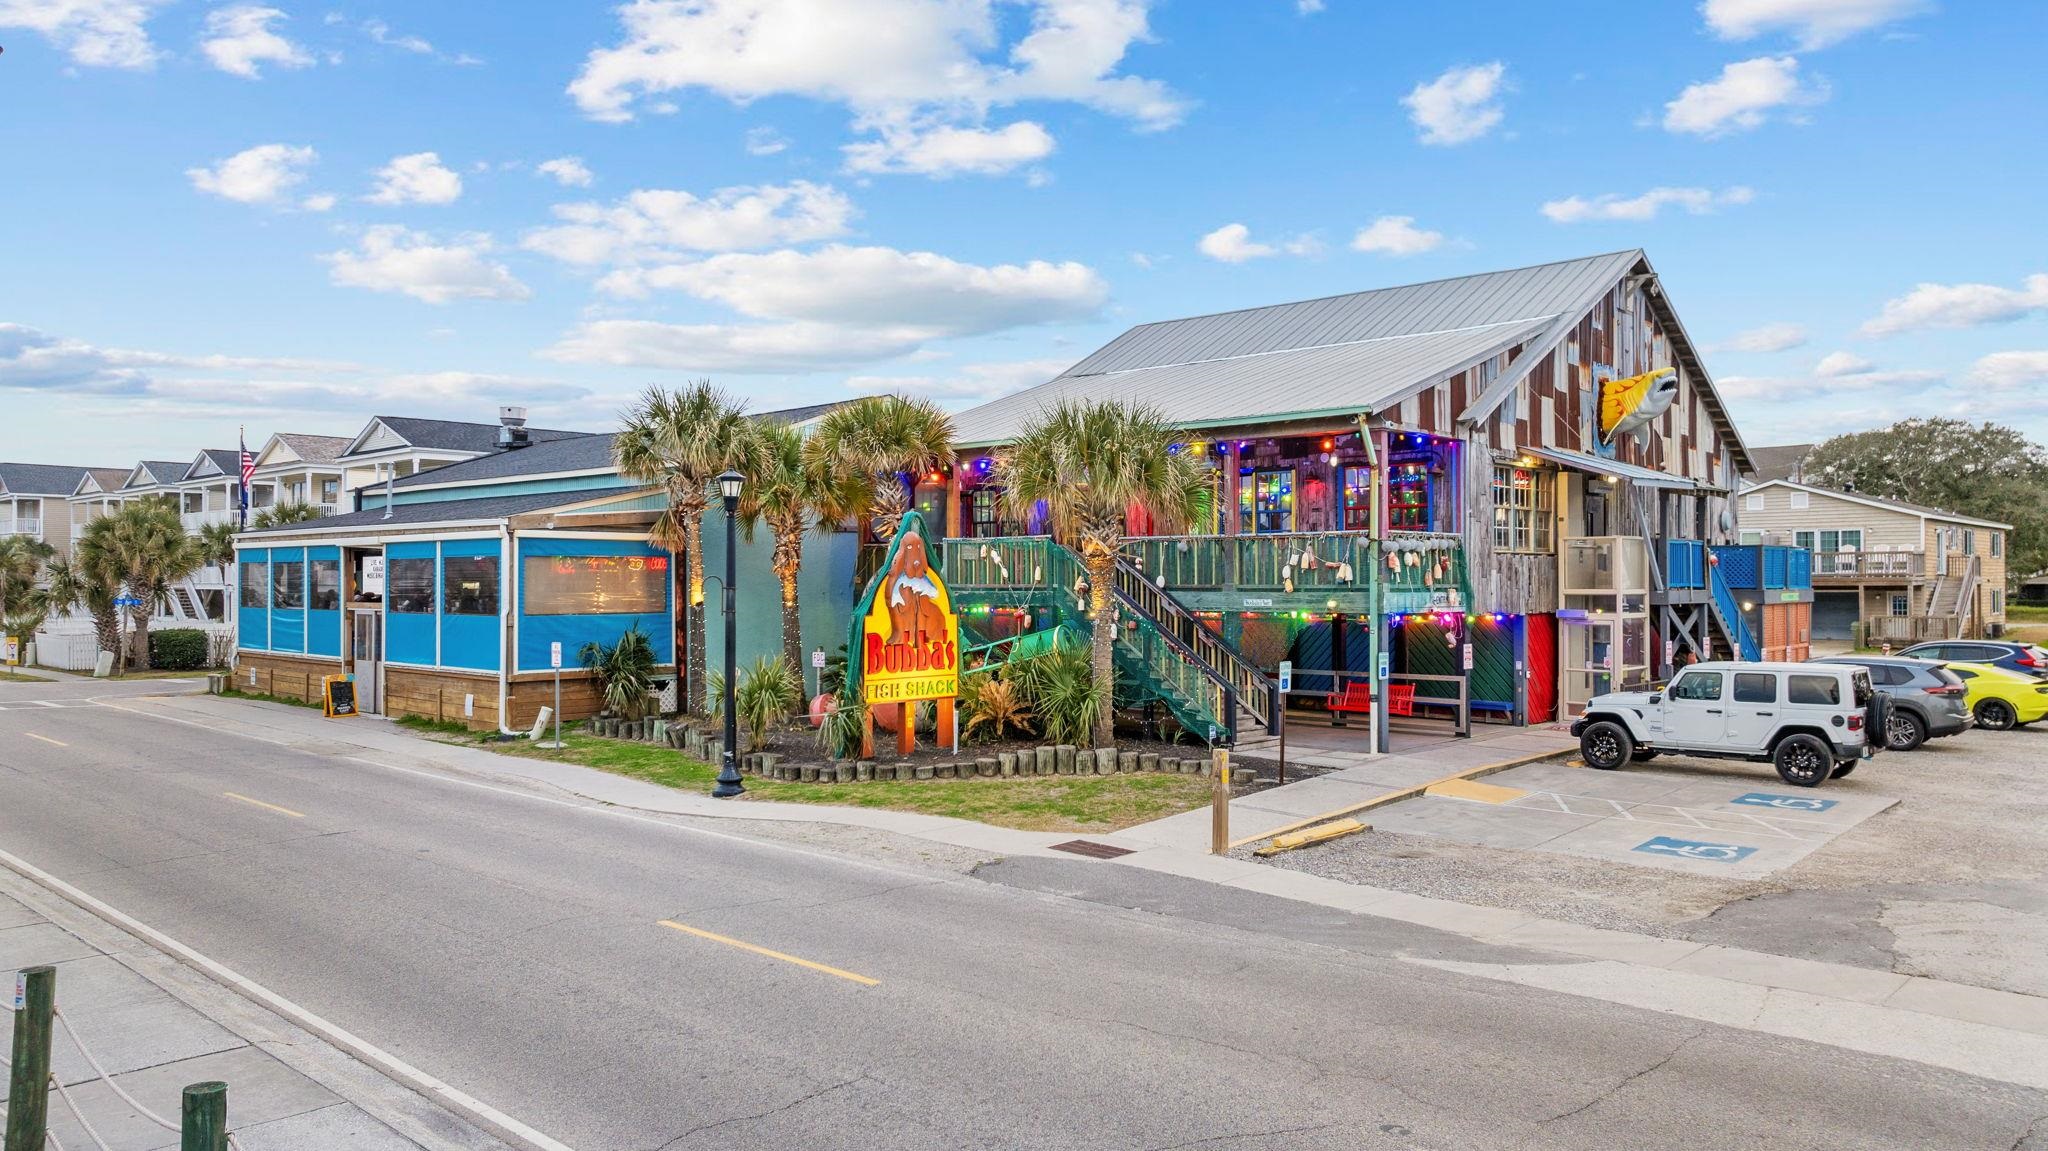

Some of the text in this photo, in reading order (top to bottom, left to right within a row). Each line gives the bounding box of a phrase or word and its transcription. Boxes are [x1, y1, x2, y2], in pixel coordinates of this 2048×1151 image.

[867, 629, 955, 675] Bubba's
[866, 679, 955, 699] FISH SHACK
